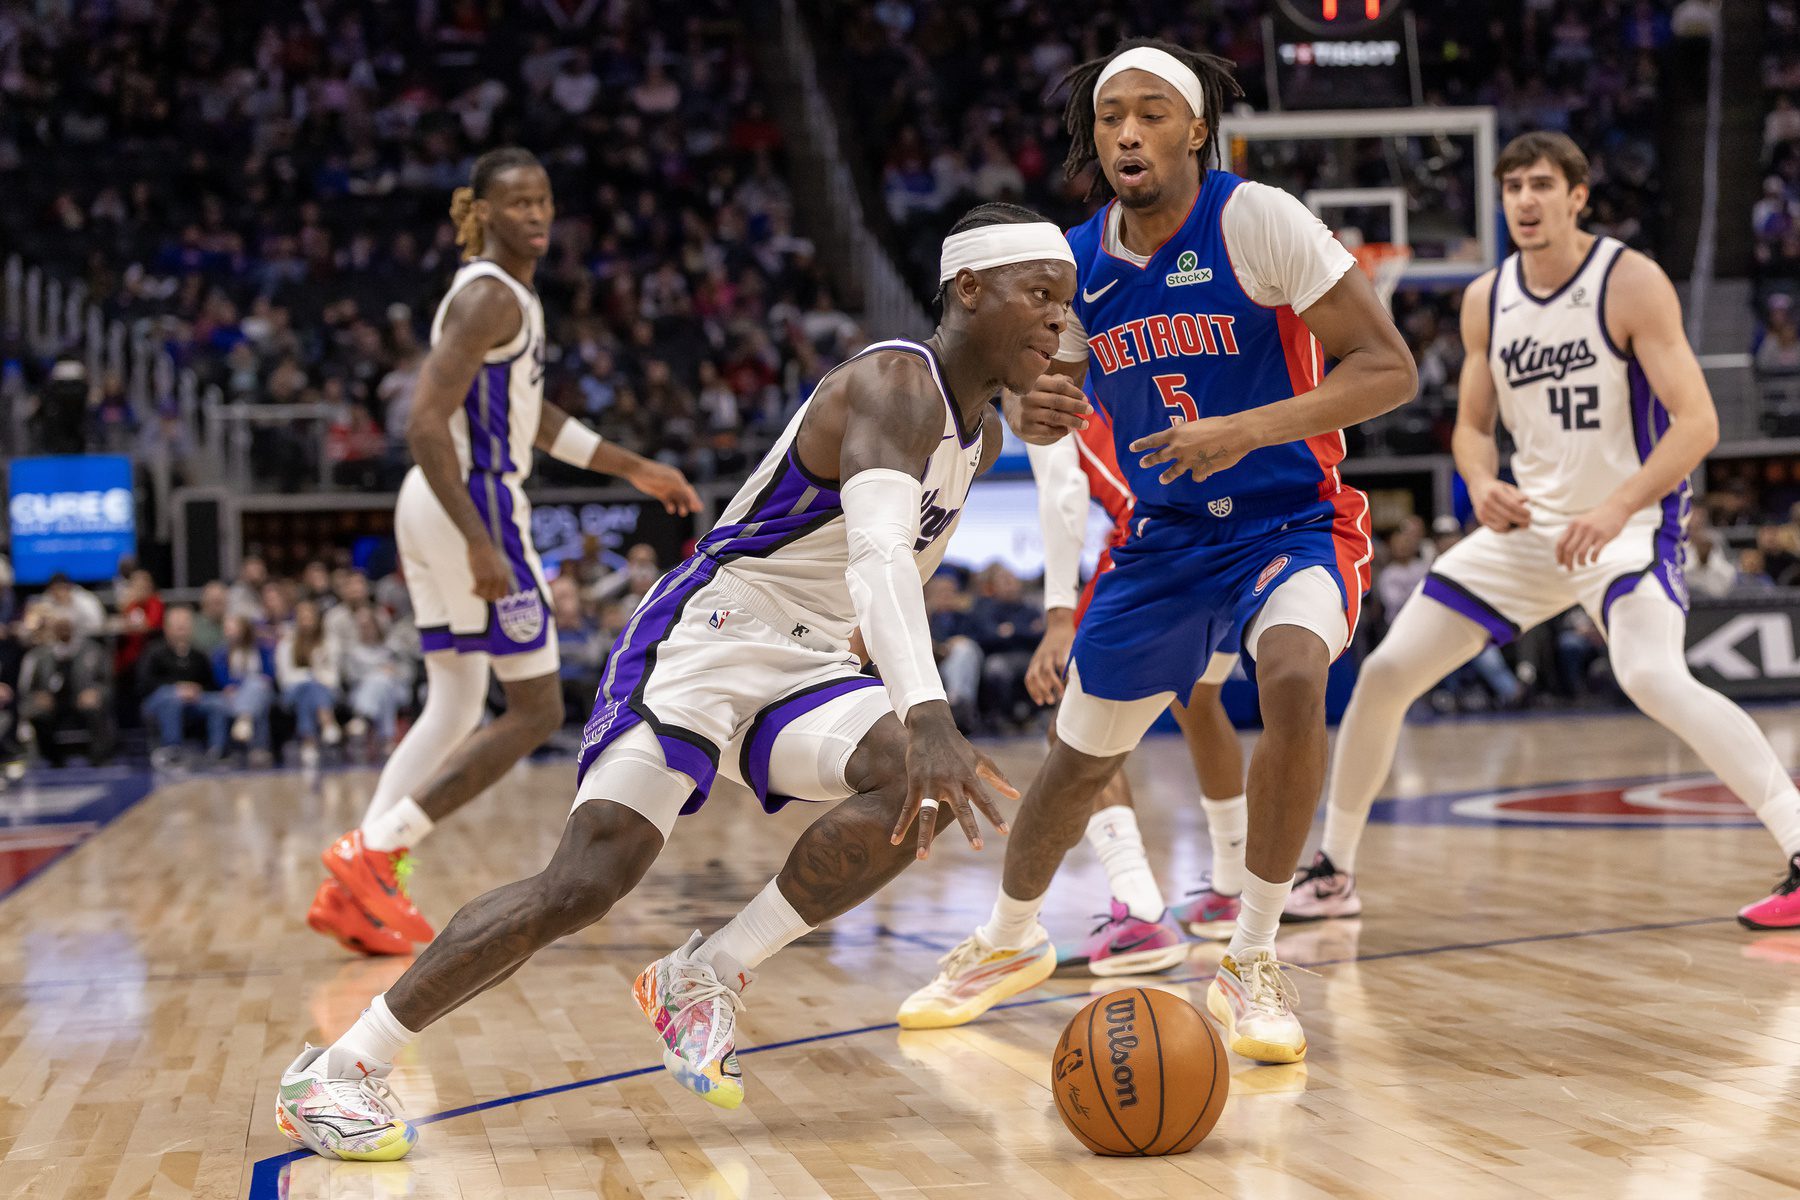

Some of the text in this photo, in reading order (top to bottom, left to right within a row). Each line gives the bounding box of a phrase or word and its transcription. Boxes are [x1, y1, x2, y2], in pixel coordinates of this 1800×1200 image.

[1168, 269, 1211, 286] StockX
[1087, 313, 1240, 376] DETROIT
[1500, 335, 1598, 389] Kings
[1152, 373, 1199, 427] 5
[1547, 385, 1600, 431] 42
[1103, 997, 1140, 1111] Wilson
